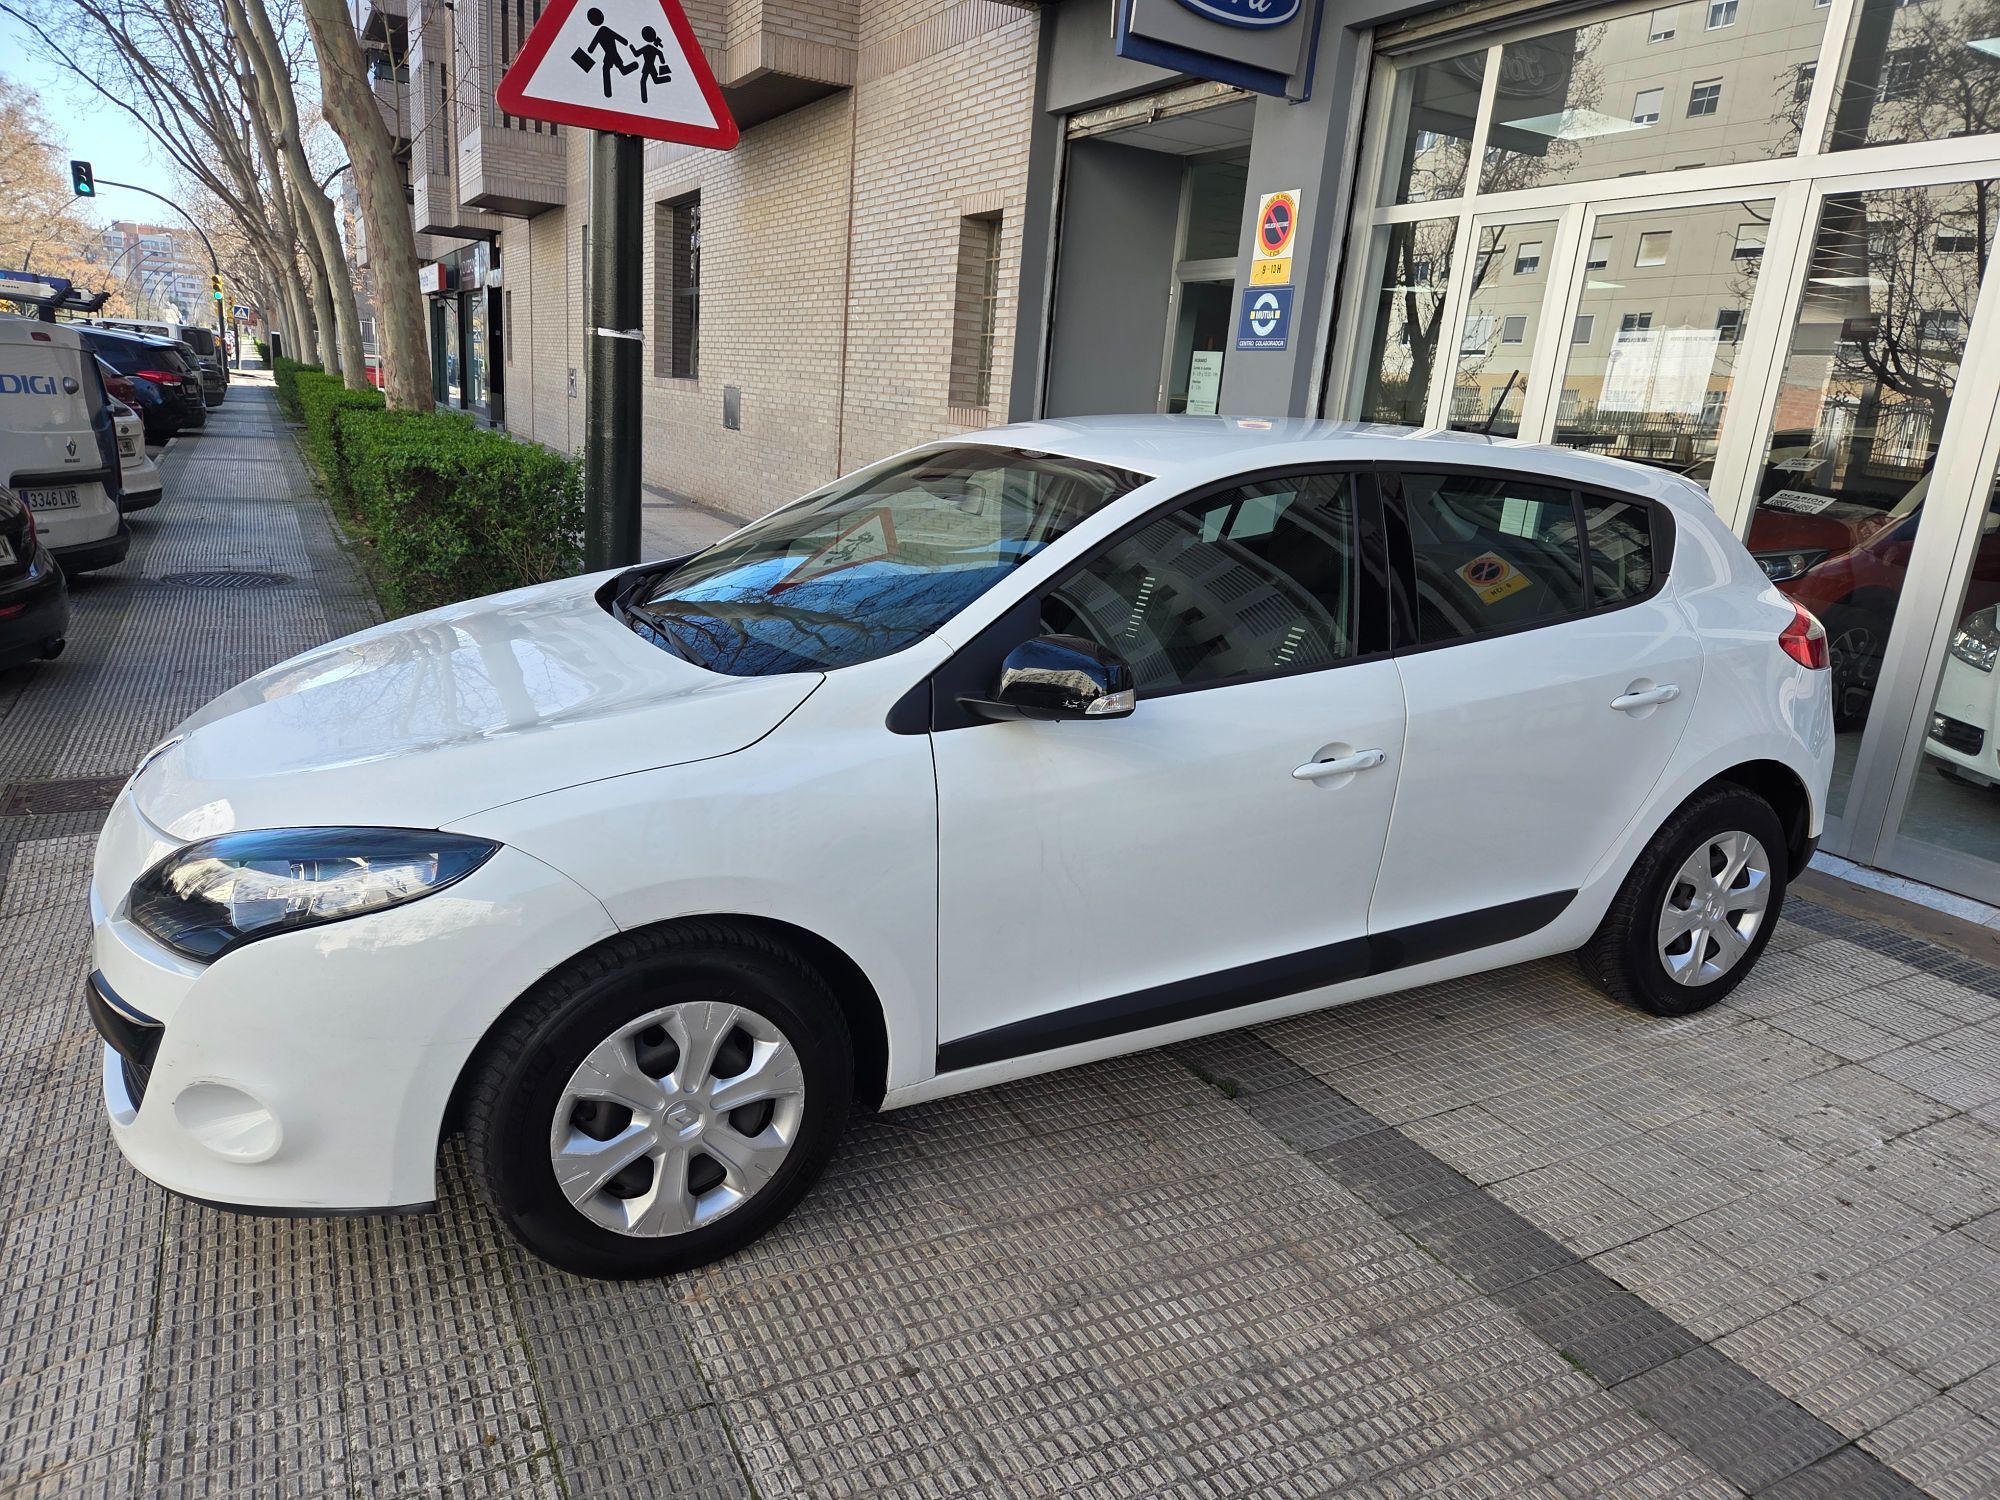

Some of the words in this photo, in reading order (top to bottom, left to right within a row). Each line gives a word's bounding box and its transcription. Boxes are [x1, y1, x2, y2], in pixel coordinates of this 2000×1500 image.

[1256, 310, 1274, 319] MUTUA
[0, 375, 57, 394] DIGI
[30, 491, 58, 507] 3346
[59, 490, 79, 505] LVR
